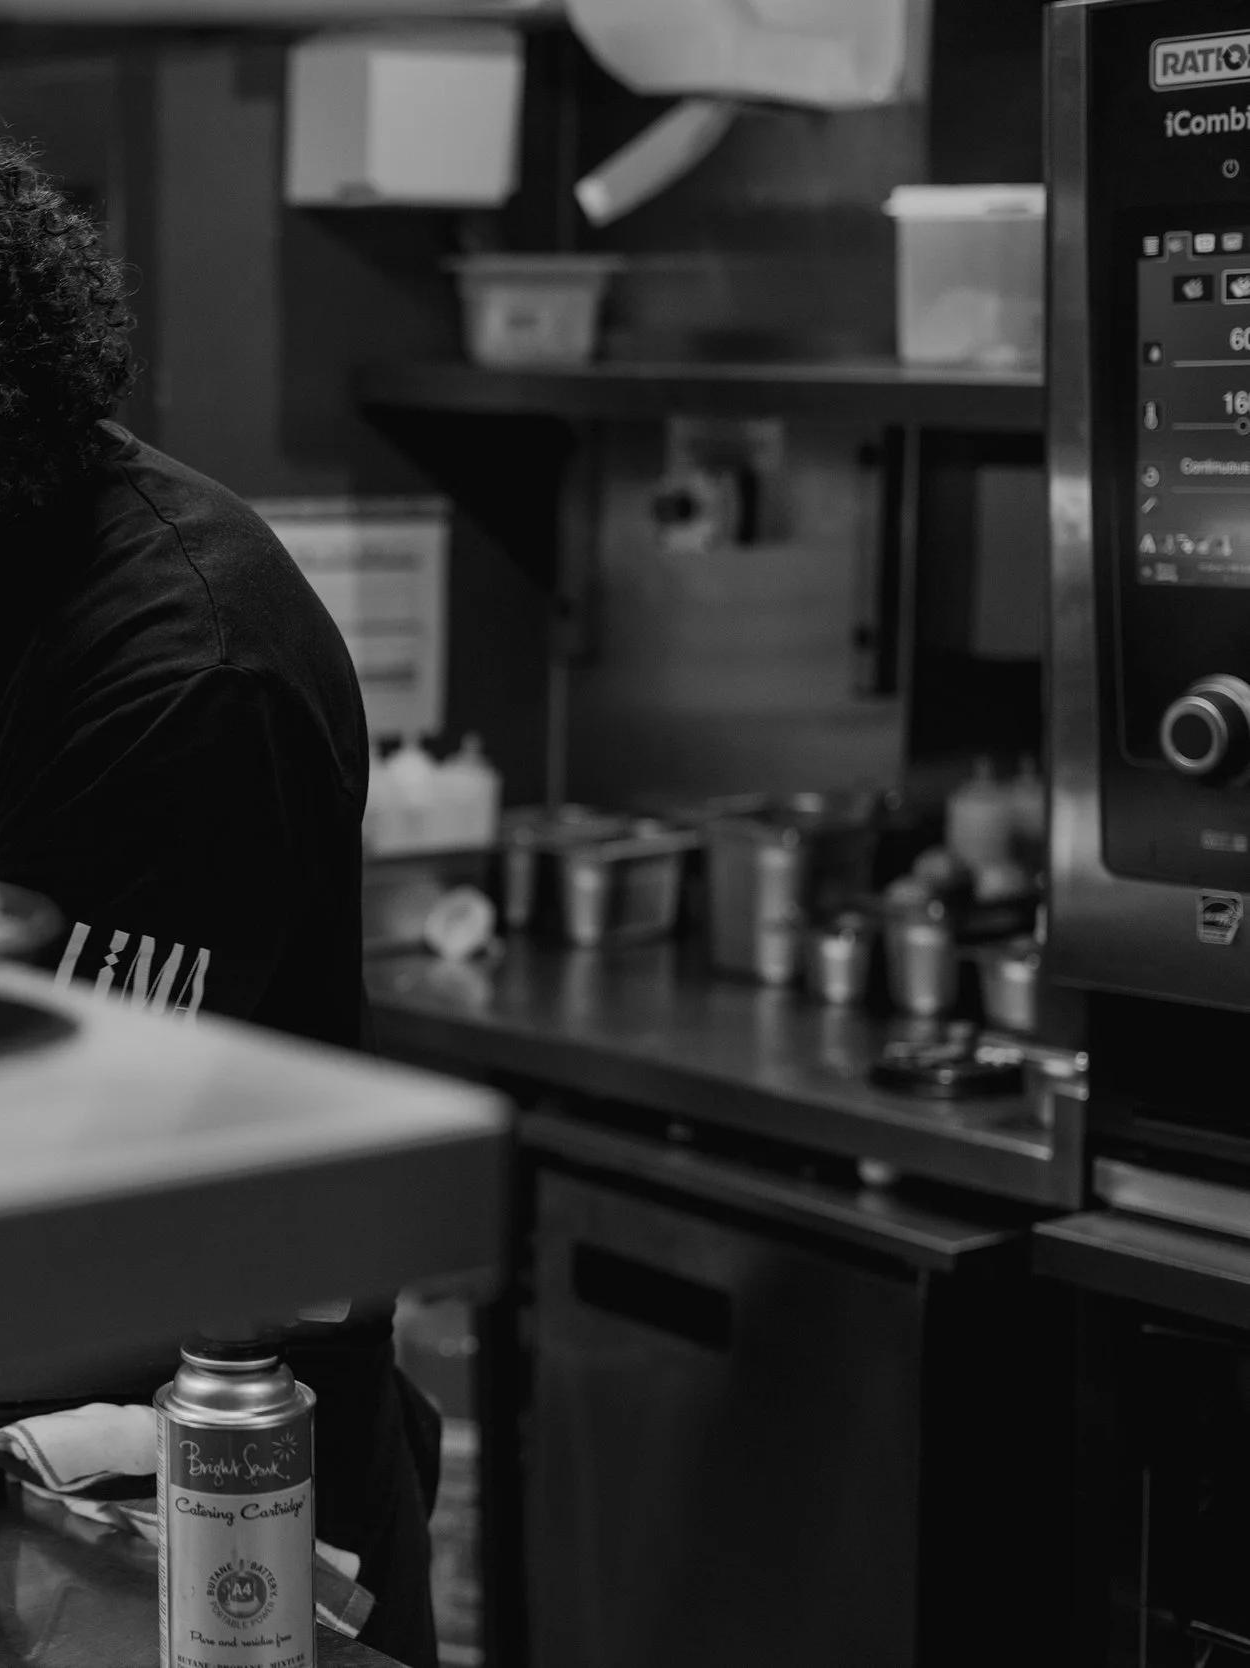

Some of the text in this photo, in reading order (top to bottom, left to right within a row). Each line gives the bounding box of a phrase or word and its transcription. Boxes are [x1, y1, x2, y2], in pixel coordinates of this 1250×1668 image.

[1162, 43, 1250, 76] RATIO
[1222, 391, 1250, 415] 16
[179, 1440, 242, 1487] Bright
[175, 1496, 235, 1526] Catering
[207, 1561, 278, 1598] BUTANE BATTERY
[189, 1630, 214, 1645] Pure
[218, 1636, 236, 1648] and
[275, 1633, 292, 1647] free
